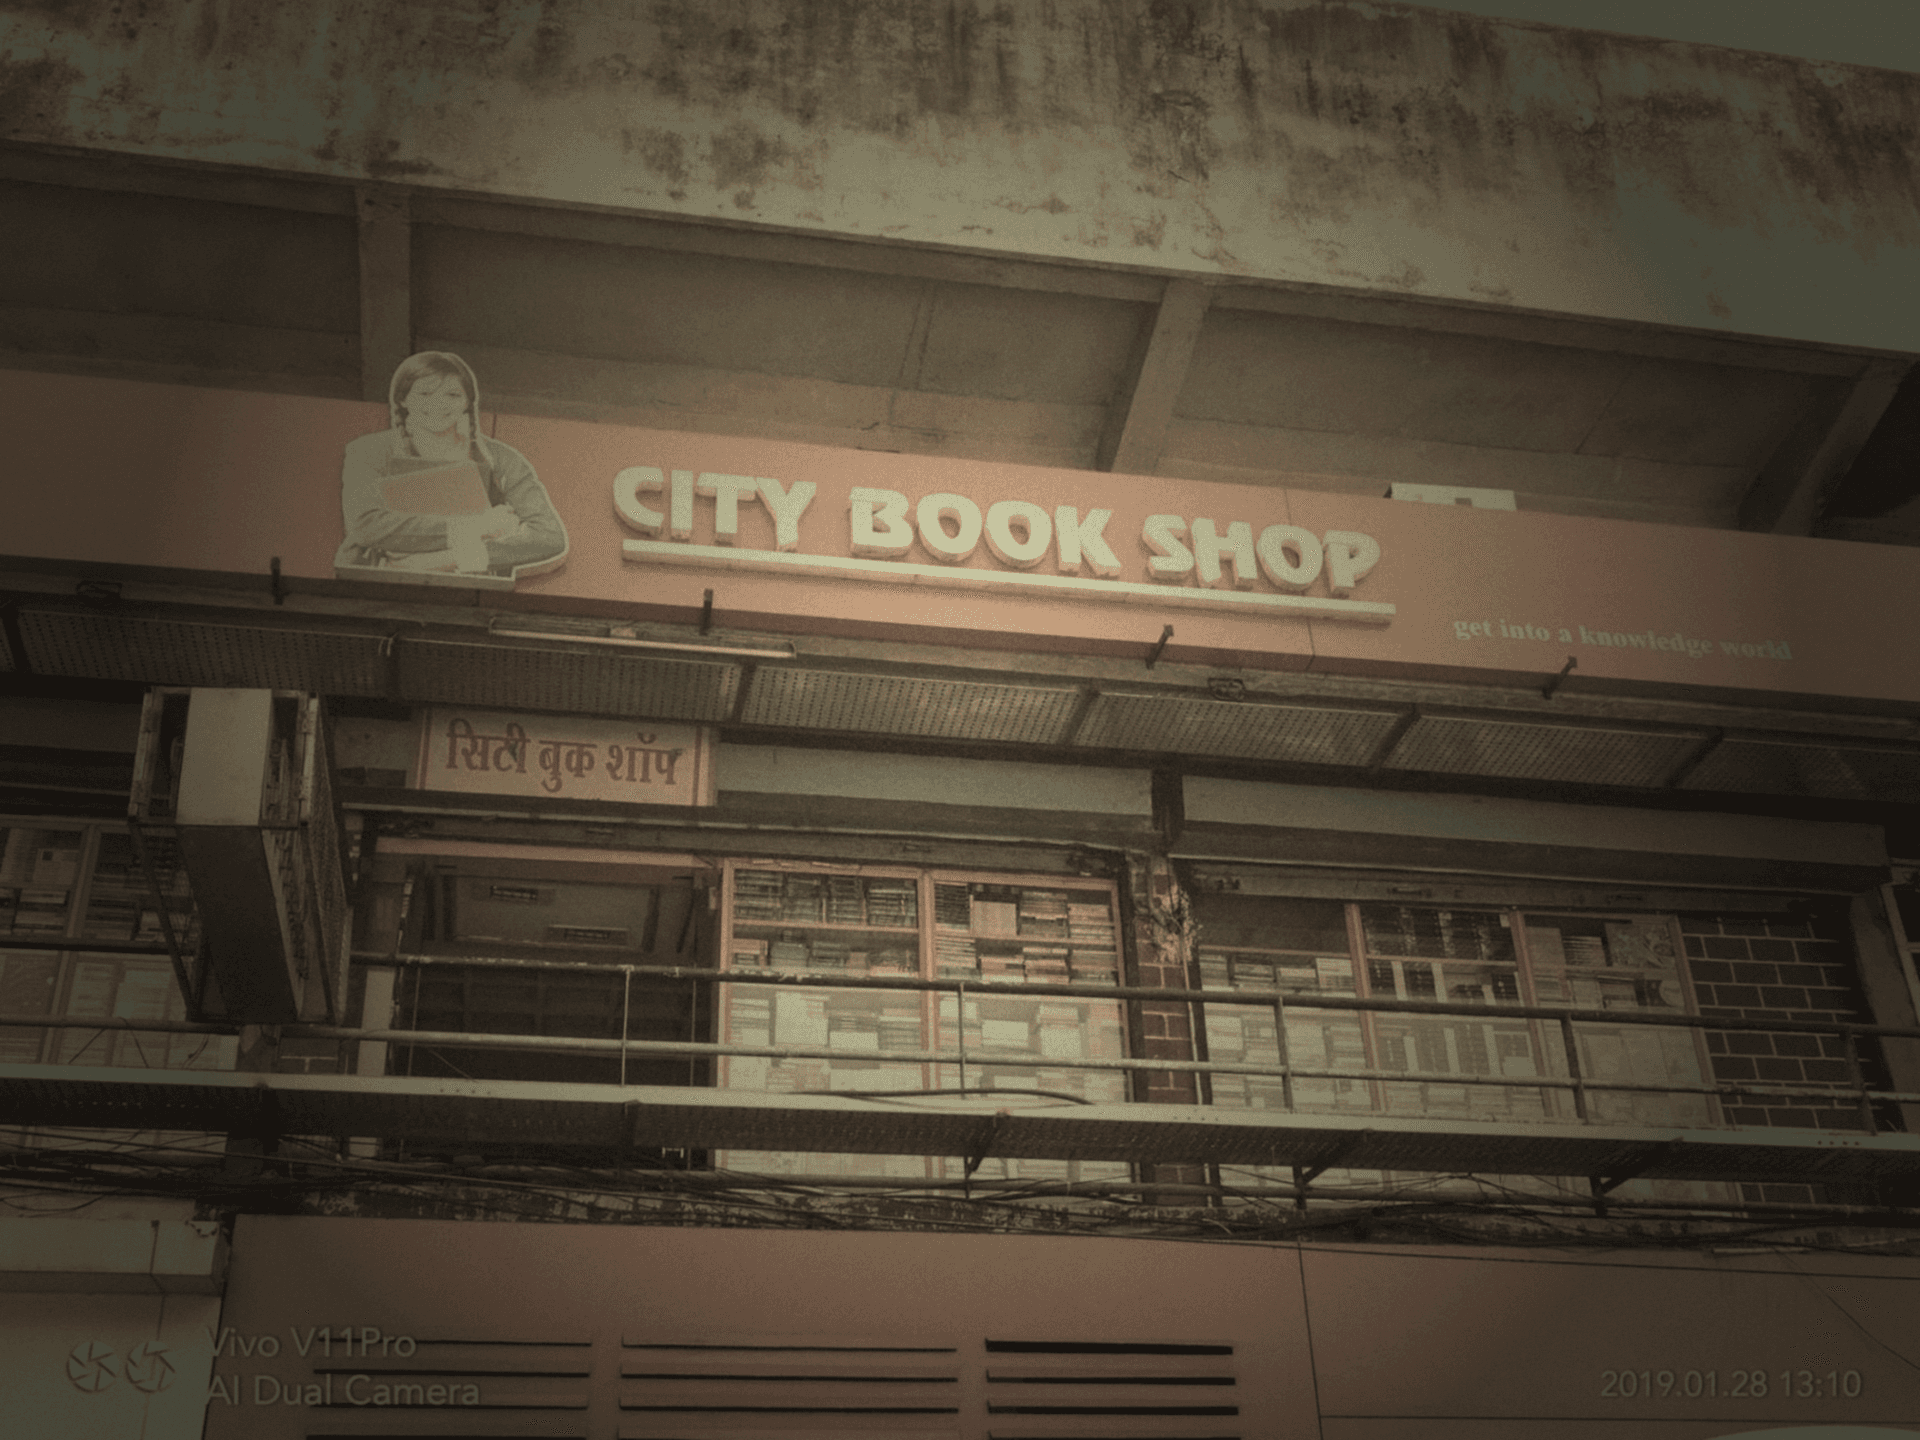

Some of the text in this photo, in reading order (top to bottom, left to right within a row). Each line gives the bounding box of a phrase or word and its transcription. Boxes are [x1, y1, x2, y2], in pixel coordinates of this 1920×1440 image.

[612, 465, 1382, 598] CITY BOOK SHOP
[1453, 618, 1794, 661] get into a knowledge world
[446, 717, 686, 793] सिटी बुक शॉप
